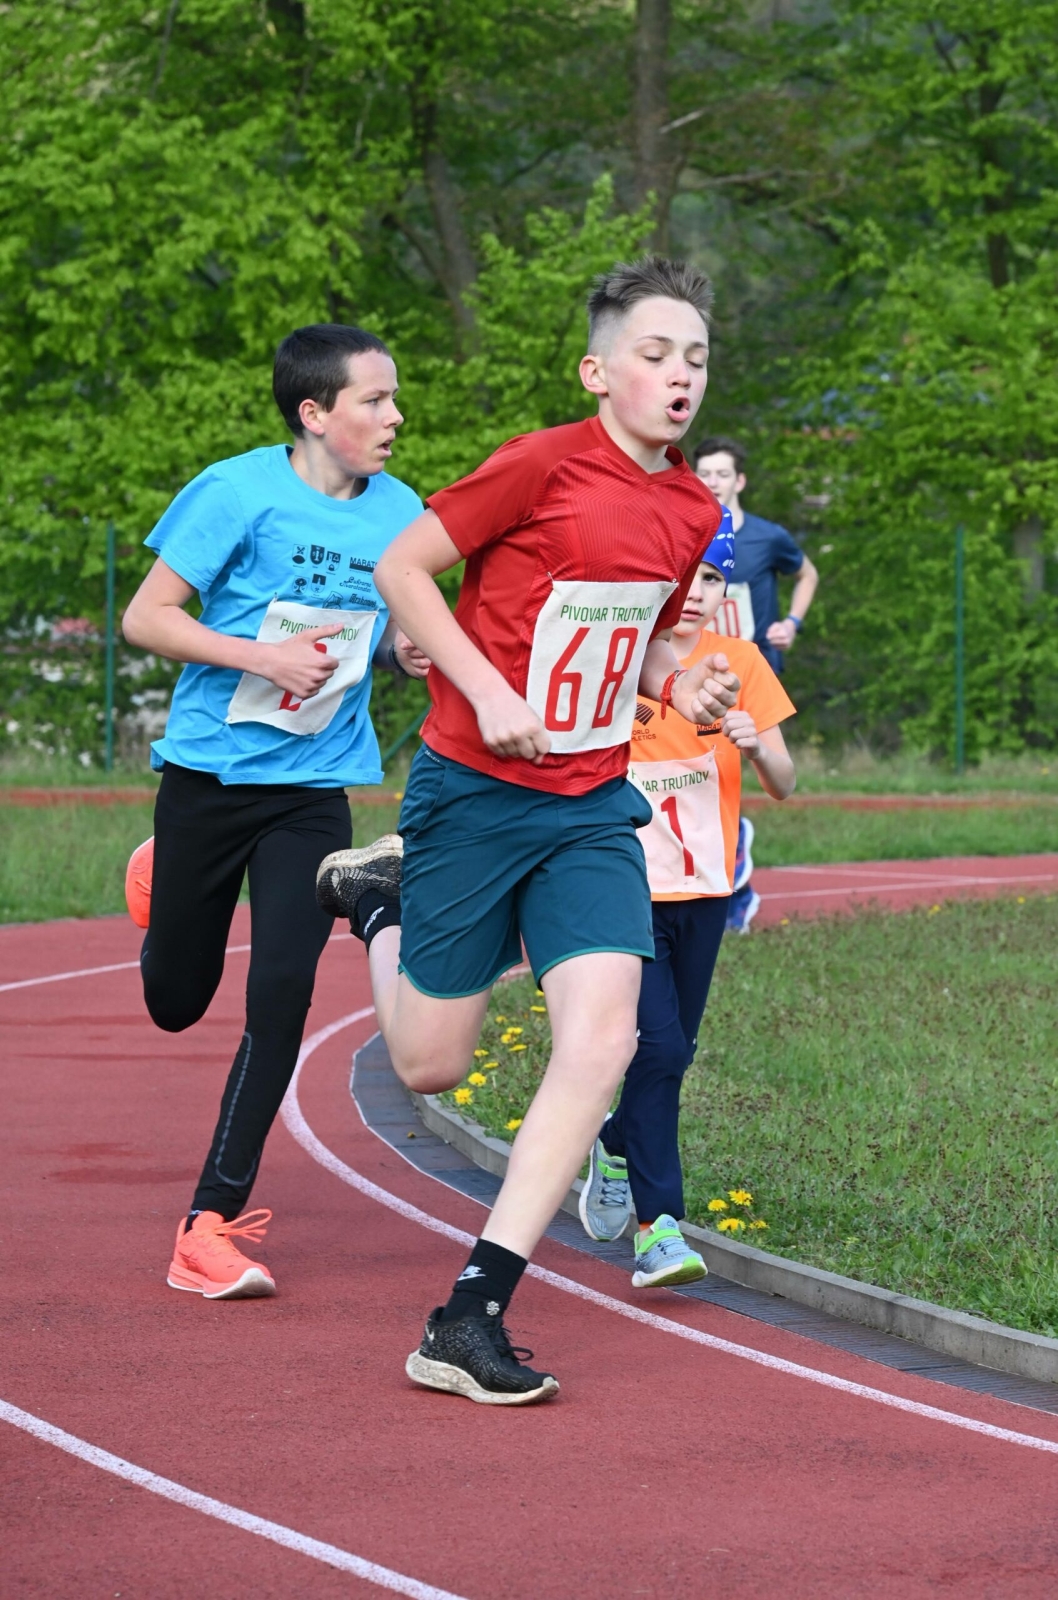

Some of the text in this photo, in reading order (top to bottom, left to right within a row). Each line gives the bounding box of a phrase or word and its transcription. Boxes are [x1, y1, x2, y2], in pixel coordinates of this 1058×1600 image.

[280, 619, 319, 635] PIVO
[560, 605, 654, 622] PIVOVAR TRUTNOV
[713, 600, 740, 638] 0
[545, 627, 638, 731] 68
[661, 771, 709, 790] TRUTNOV
[660, 796, 695, 876] 1
